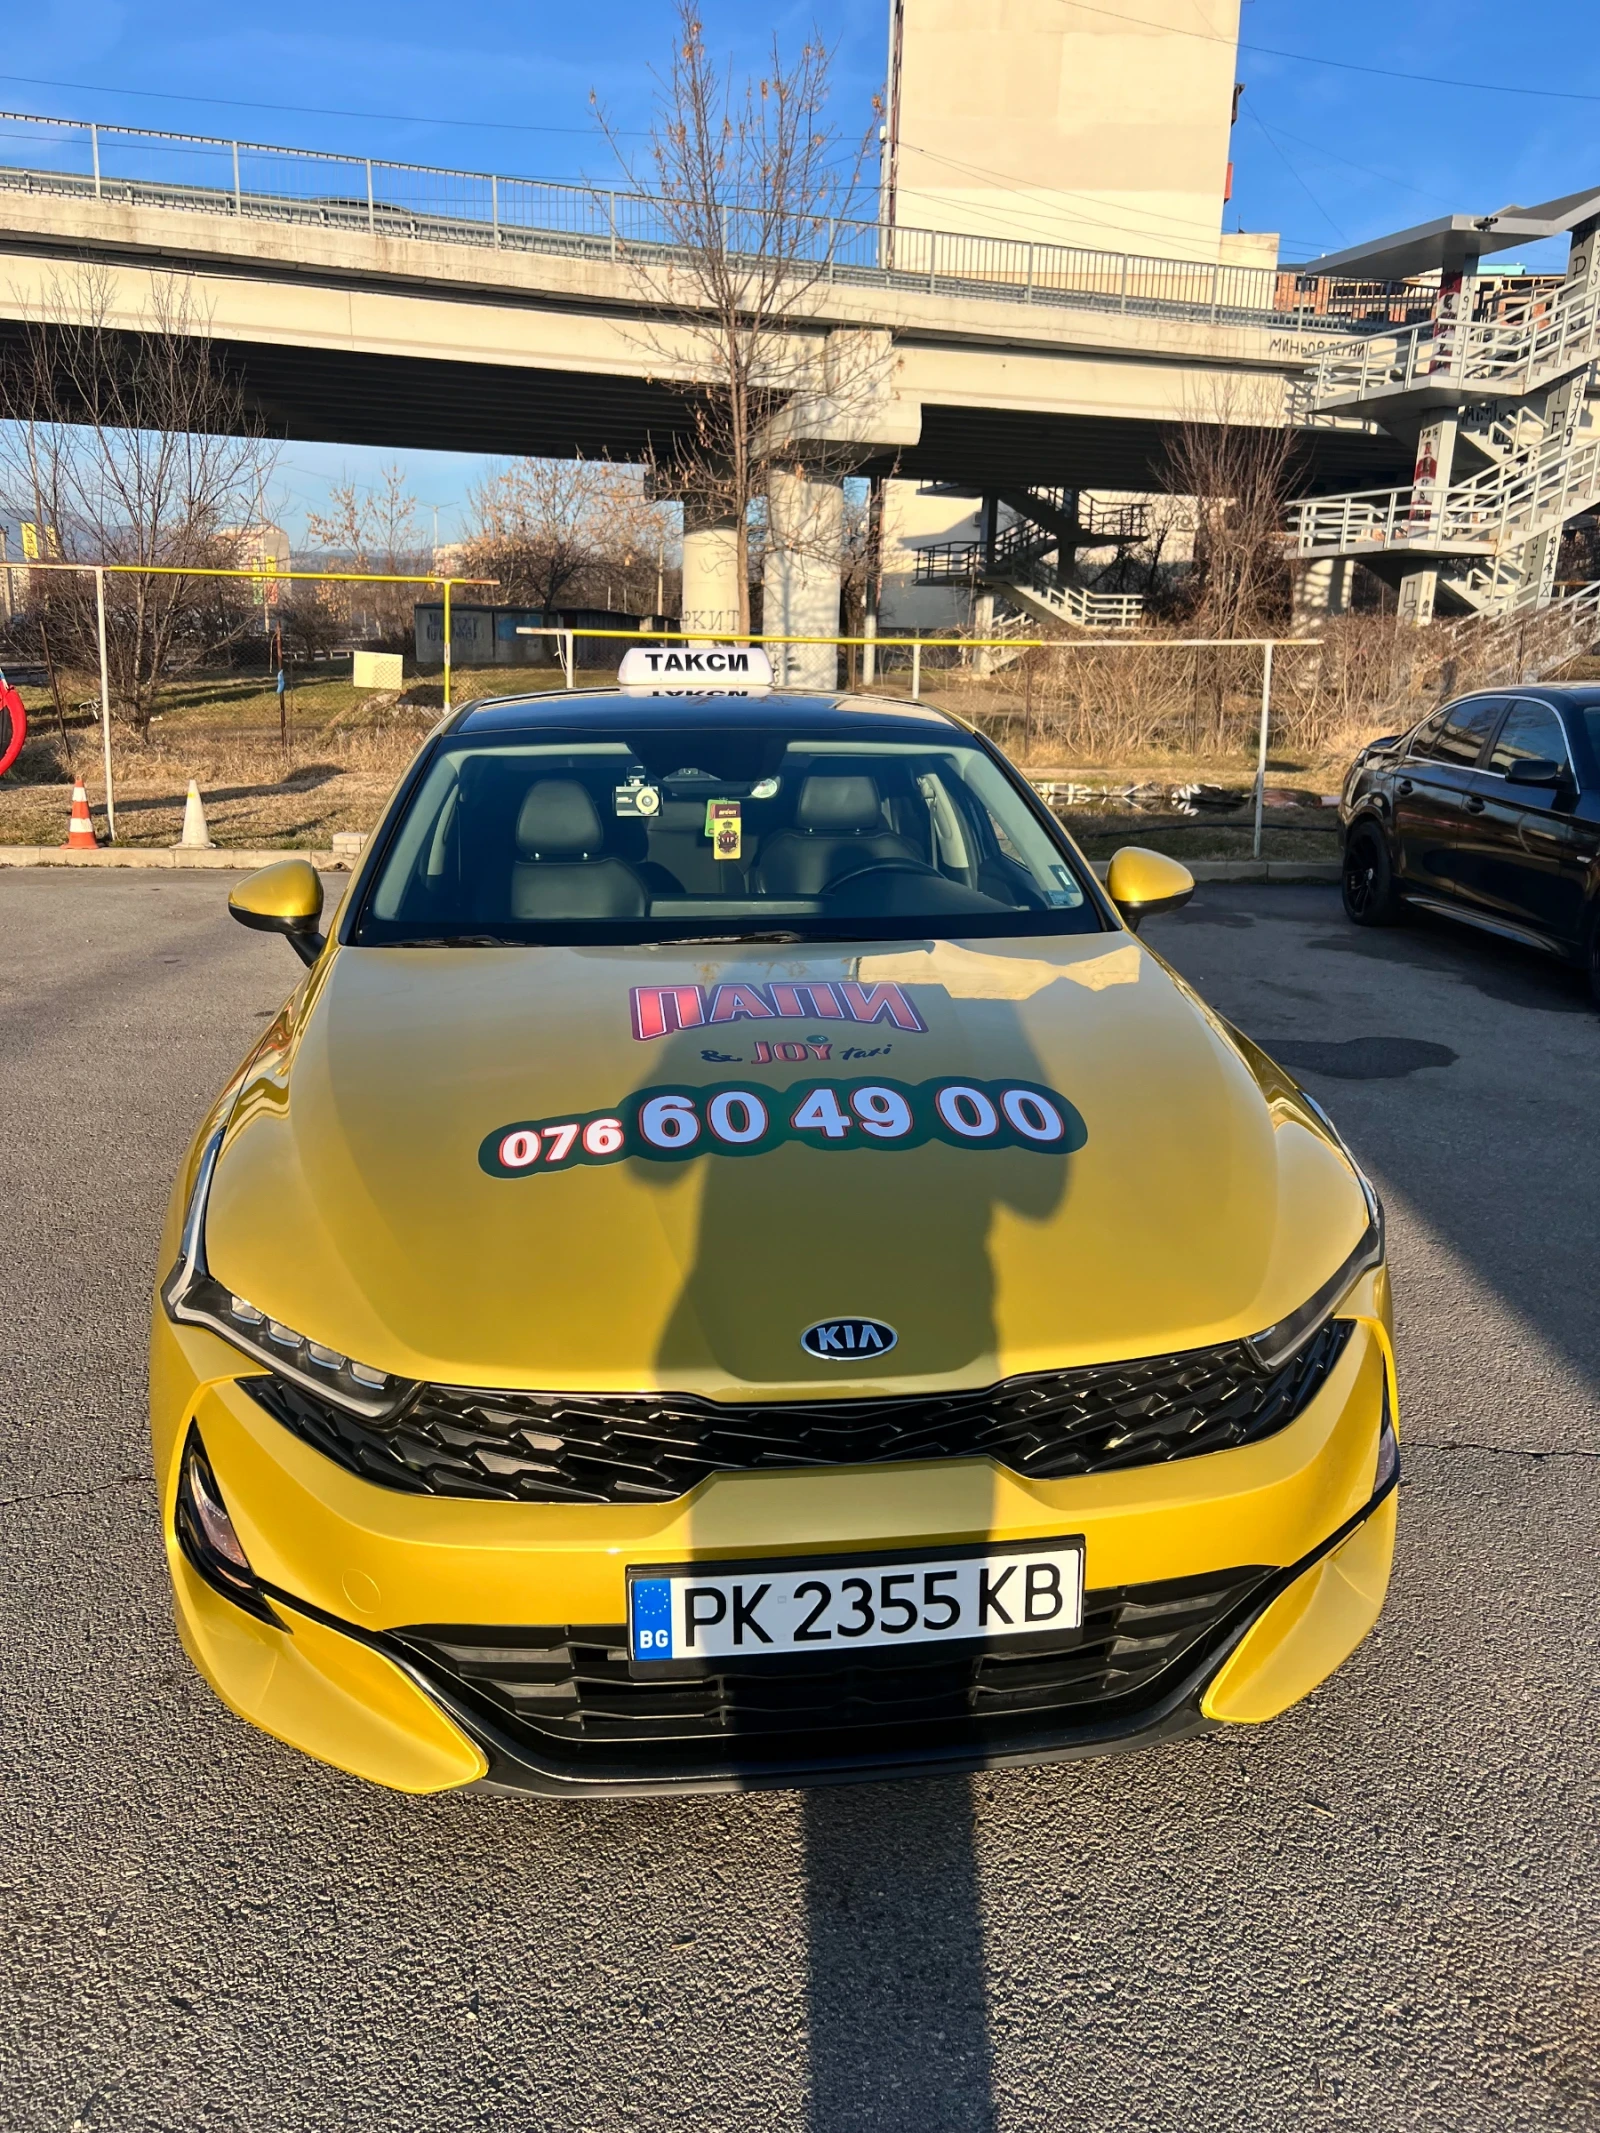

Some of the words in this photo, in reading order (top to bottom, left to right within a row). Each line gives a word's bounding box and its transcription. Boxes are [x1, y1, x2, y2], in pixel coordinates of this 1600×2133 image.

[1328, 341, 1373, 357] ПЕРНИ
[645, 654, 749, 672] ТАКСИ
[629, 982, 929, 1042] ПАПИ
[751, 1040, 833, 1064] JOY
[499, 1117, 625, 1168] 076
[639, 1090, 769, 1149] 60
[791, 1086, 913, 1138] 49
[934, 1086, 1065, 1142] 00
[817, 1324, 884, 1351] KIA
[684, 1583, 774, 1647] PK
[793, 1570, 961, 1642] 2355
[977, 1562, 1064, 1627] KB
[639, 1629, 669, 1648] BG
